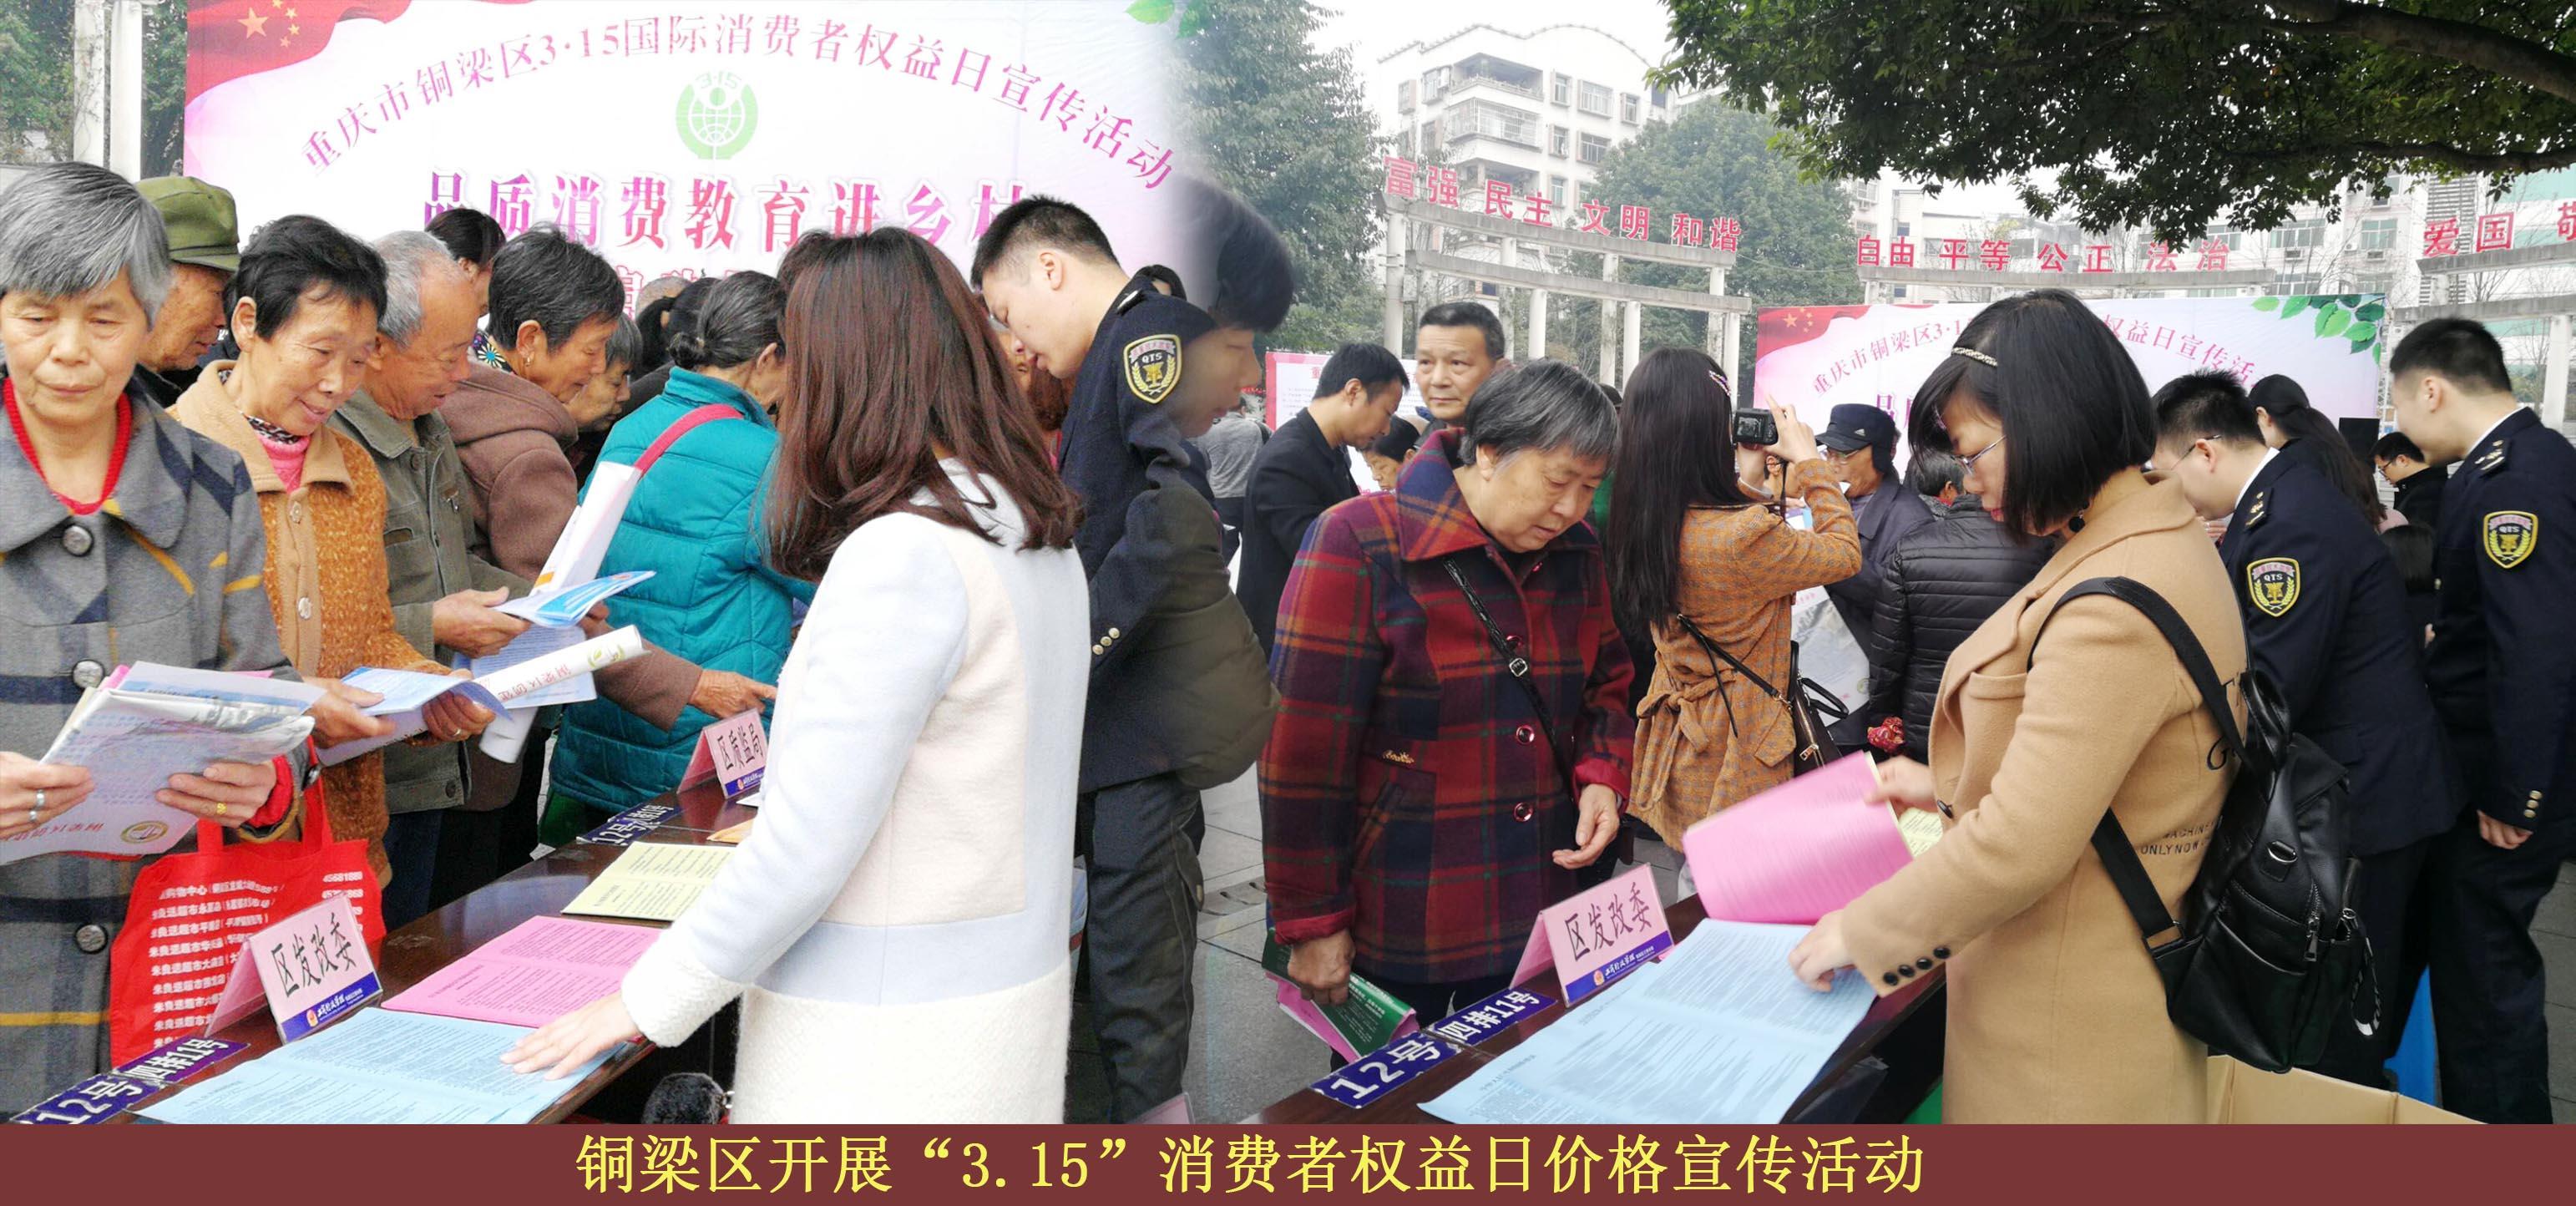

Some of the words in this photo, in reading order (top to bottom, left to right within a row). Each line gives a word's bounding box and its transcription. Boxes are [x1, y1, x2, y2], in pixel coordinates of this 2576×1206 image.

[1384, 155, 1460, 209] 富强
[1484, 179, 1553, 228] 民主
[1581, 199, 1652, 242] 文明
[1672, 211, 1743, 253] 和谐
[1857, 234, 1915, 267] 自由
[1939, 239, 2011, 271] 平等
[2037, 242, 2113, 273] 公正
[2145, 236, 2231, 272] 法治
[2423, 210, 2516, 257] 爱国
[1141, 352, 1163, 364] QTS
[2264, 573, 2284, 582] QTS
[1564, 881, 1652, 961] 区发改委
[271, 911, 357, 998] 区发改委
[1437, 990, 1541, 1044] 四排11号
[1330, 1039, 1441, 1100] 12号
